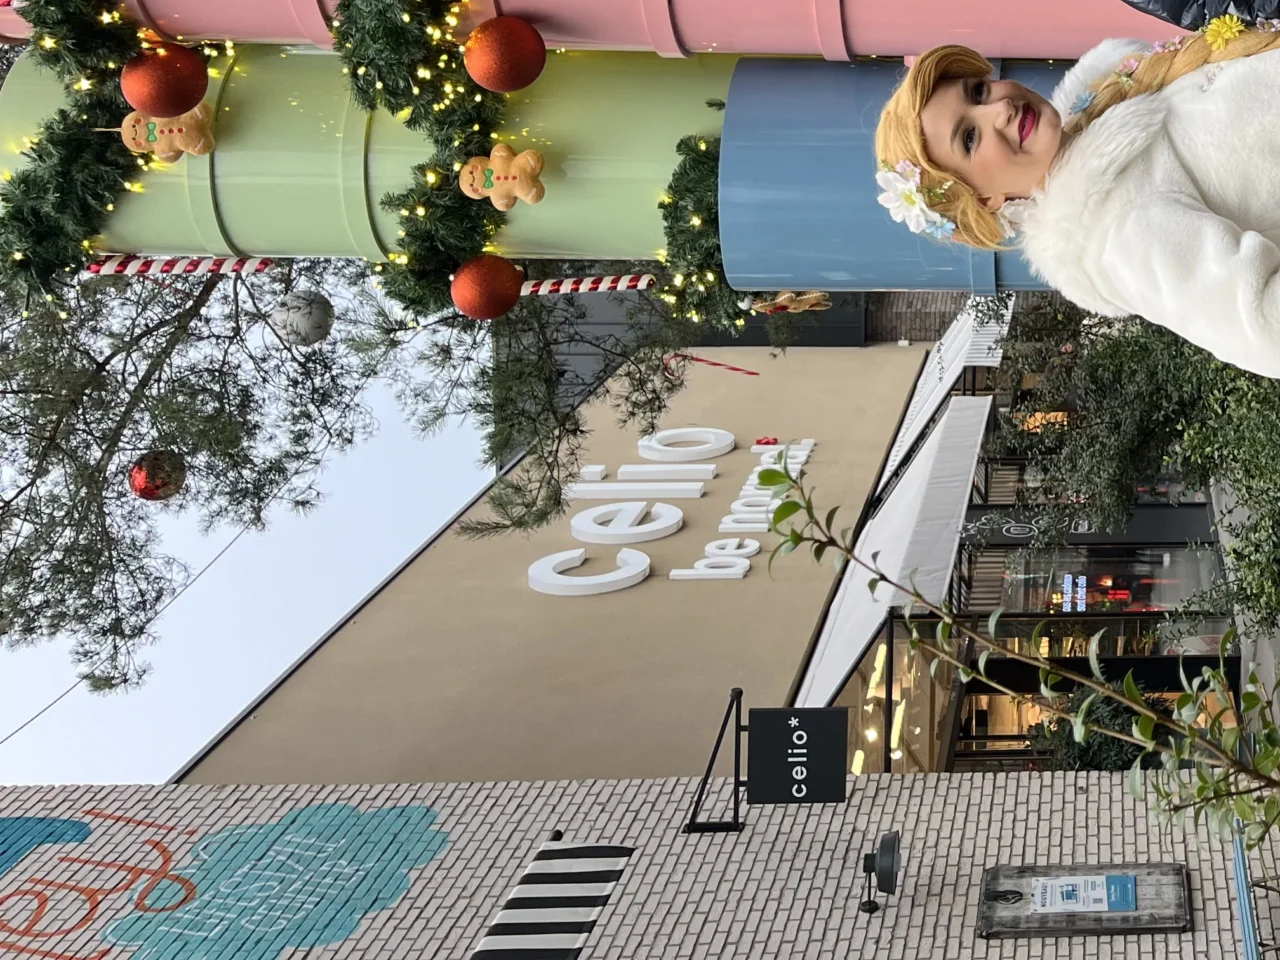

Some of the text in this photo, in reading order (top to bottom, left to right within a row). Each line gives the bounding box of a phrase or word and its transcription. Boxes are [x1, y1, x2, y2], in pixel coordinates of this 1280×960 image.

[527, 427, 735, 596] celio
[668, 537, 760, 580] be
[1062, 602, 1072, 612] ous
[1074, 575, 1087, 612] sont chez celio
[156, 832, 346, 938] LIFESTYLE
[240, 861, 380, 932] CENTER
